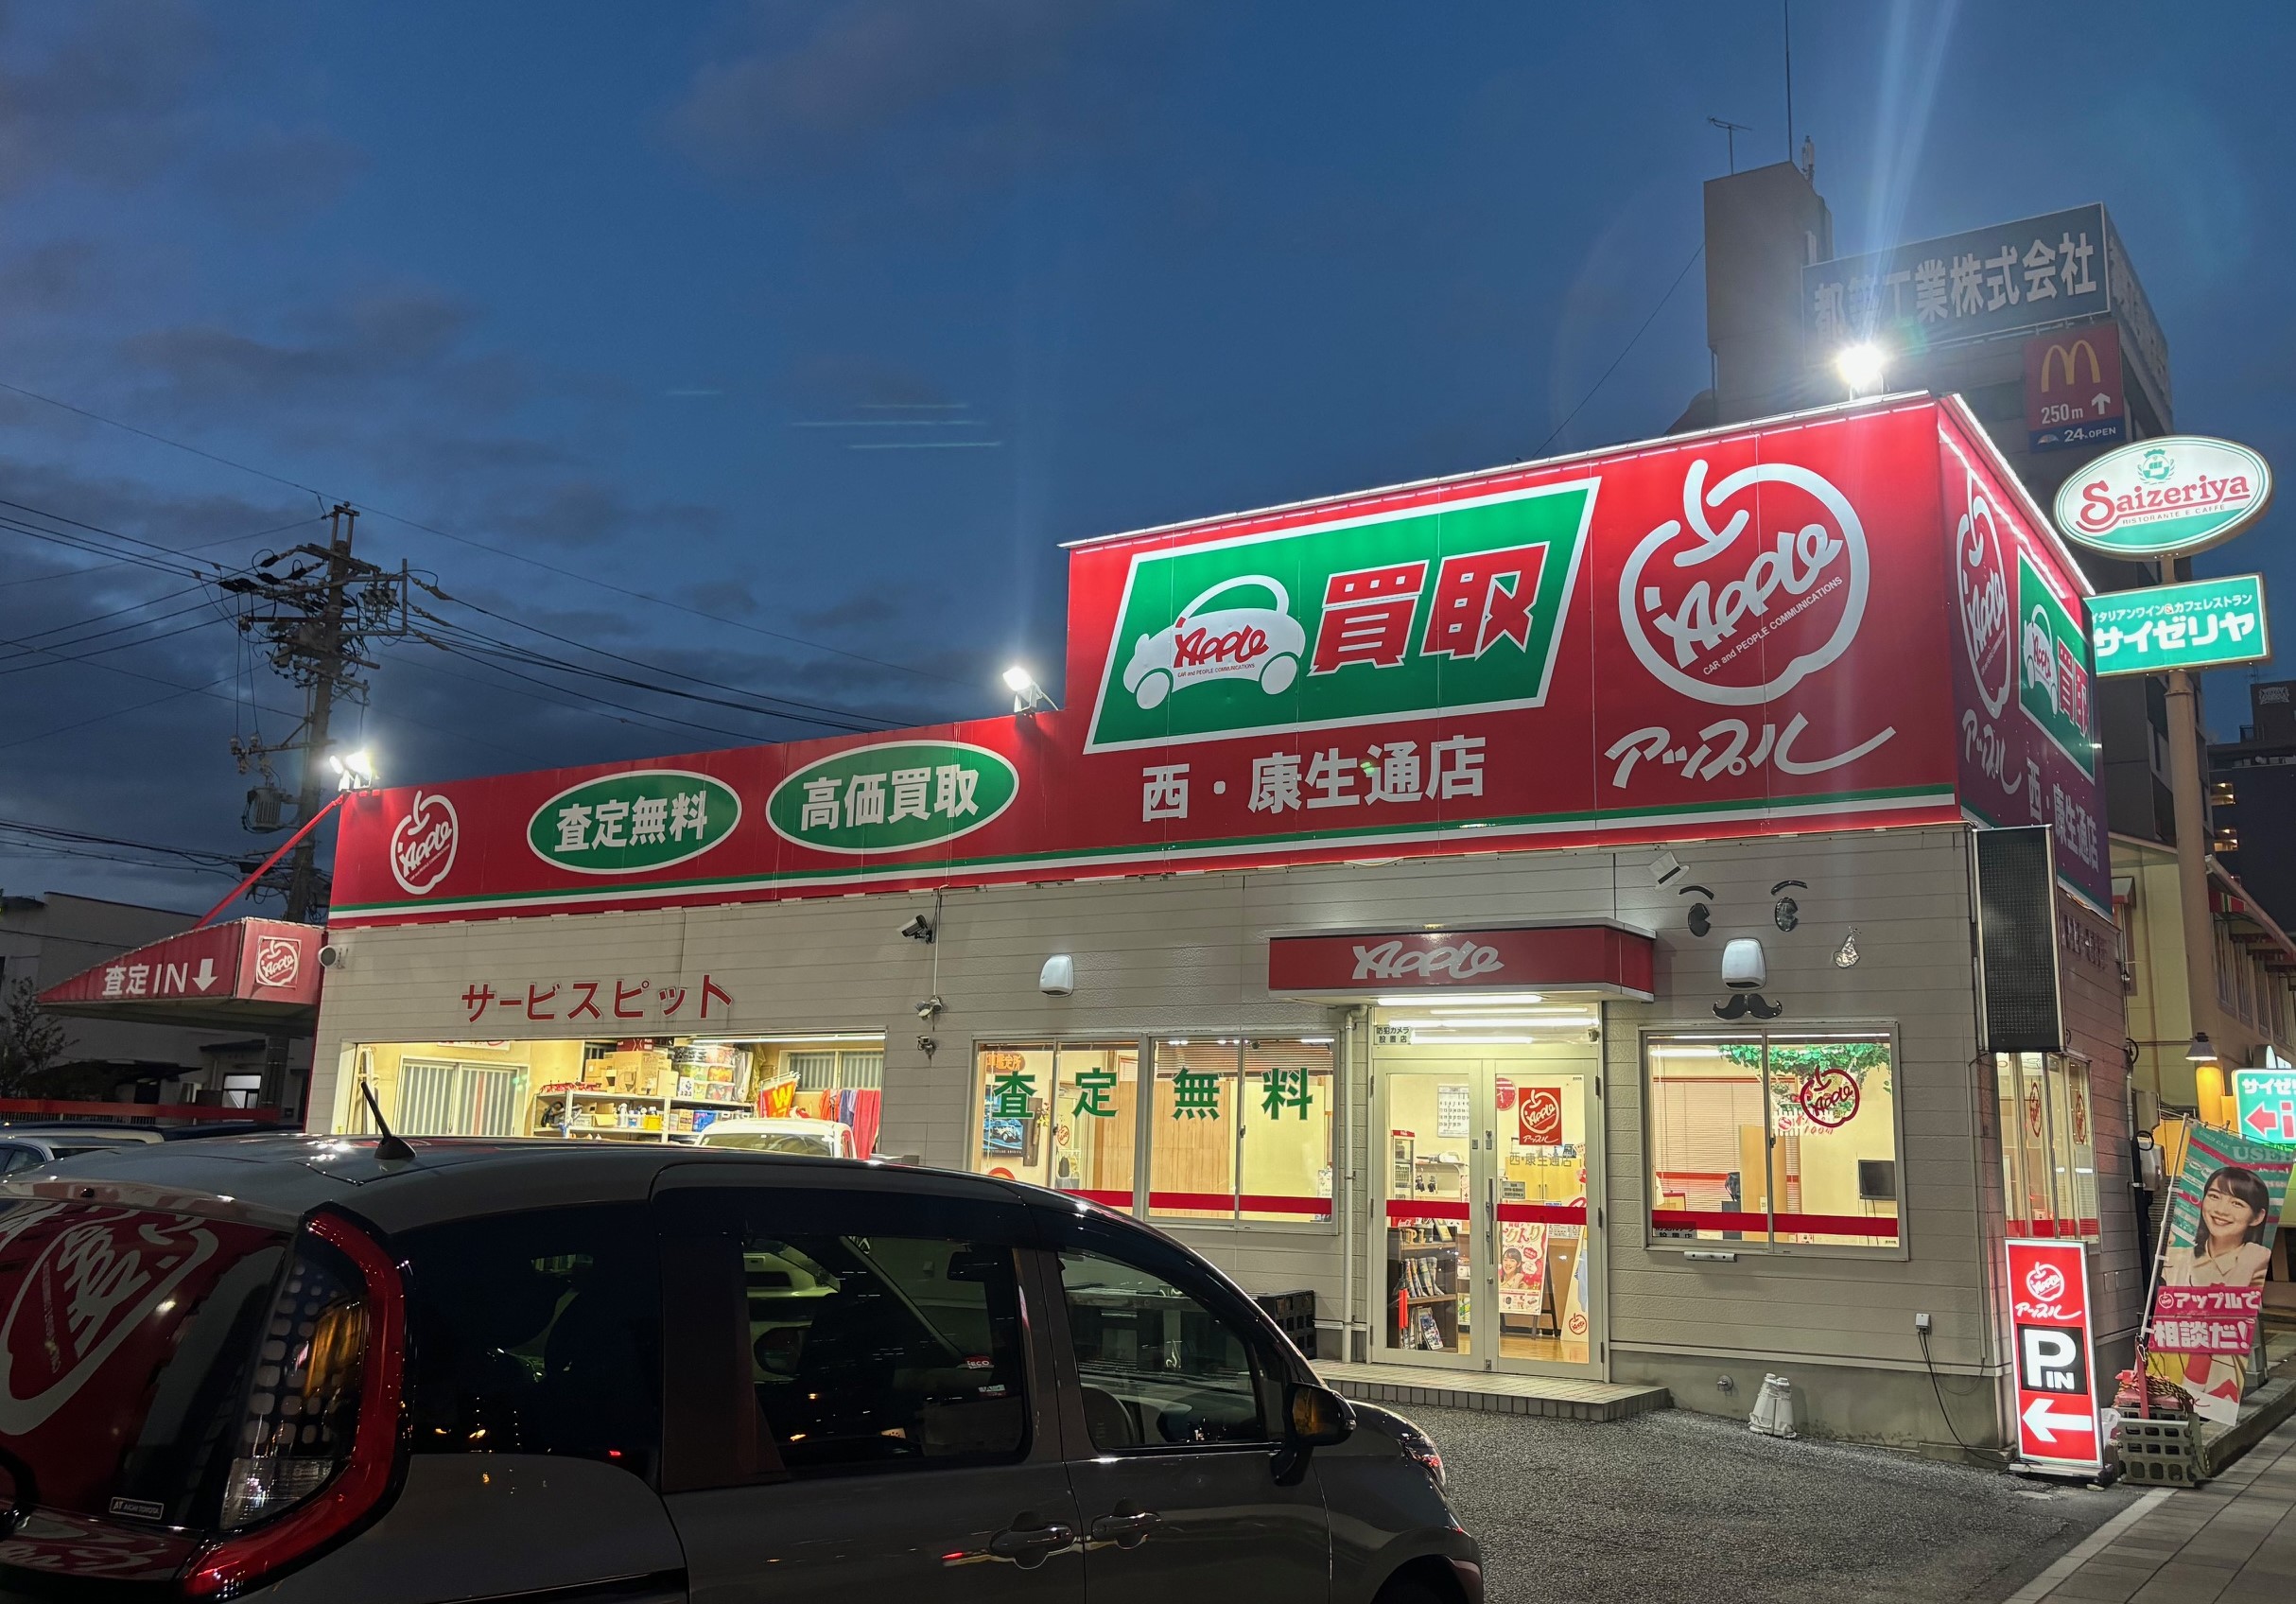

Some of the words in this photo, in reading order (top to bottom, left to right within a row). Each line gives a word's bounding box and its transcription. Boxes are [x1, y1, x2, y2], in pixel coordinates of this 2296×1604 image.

[2089, 427, 2116, 438] OPEN
[2079, 475, 2250, 527] Saizeriya
[2122, 512, 2181, 525] RISTORANTE
[1307, 541, 1551, 677] 買取
[1644, 524, 1844, 669] Apple
[1174, 616, 1269, 669] Apple
[1703, 659, 1721, 676] CAR
[1720, 649, 1737, 665] and
[1735, 626, 1770, 655] PEOPLE
[1768, 576, 1844, 631] COMMUNICATIONS
[2094, 611, 2255, 657] サイゼリヤ
[1604, 712, 1897, 789] アップル
[800, 762, 981, 832] 高価買取
[554, 791, 708, 855] 査定無料
[397, 821, 453, 879] Apple
[1352, 940, 1505, 980] Apple
[461, 973, 735, 1022] サービスピット
[1376, 1026, 1410, 1035] 防犯カメラ
[1524, 1103, 1556, 1126] Apple
[2015, 1301, 2082, 1320] アップル
[2173, 1290, 2261, 1310] アップルで
[2153, 1320, 2250, 1351] 相談だ!
[2045, 1370, 2075, 1390] IN
